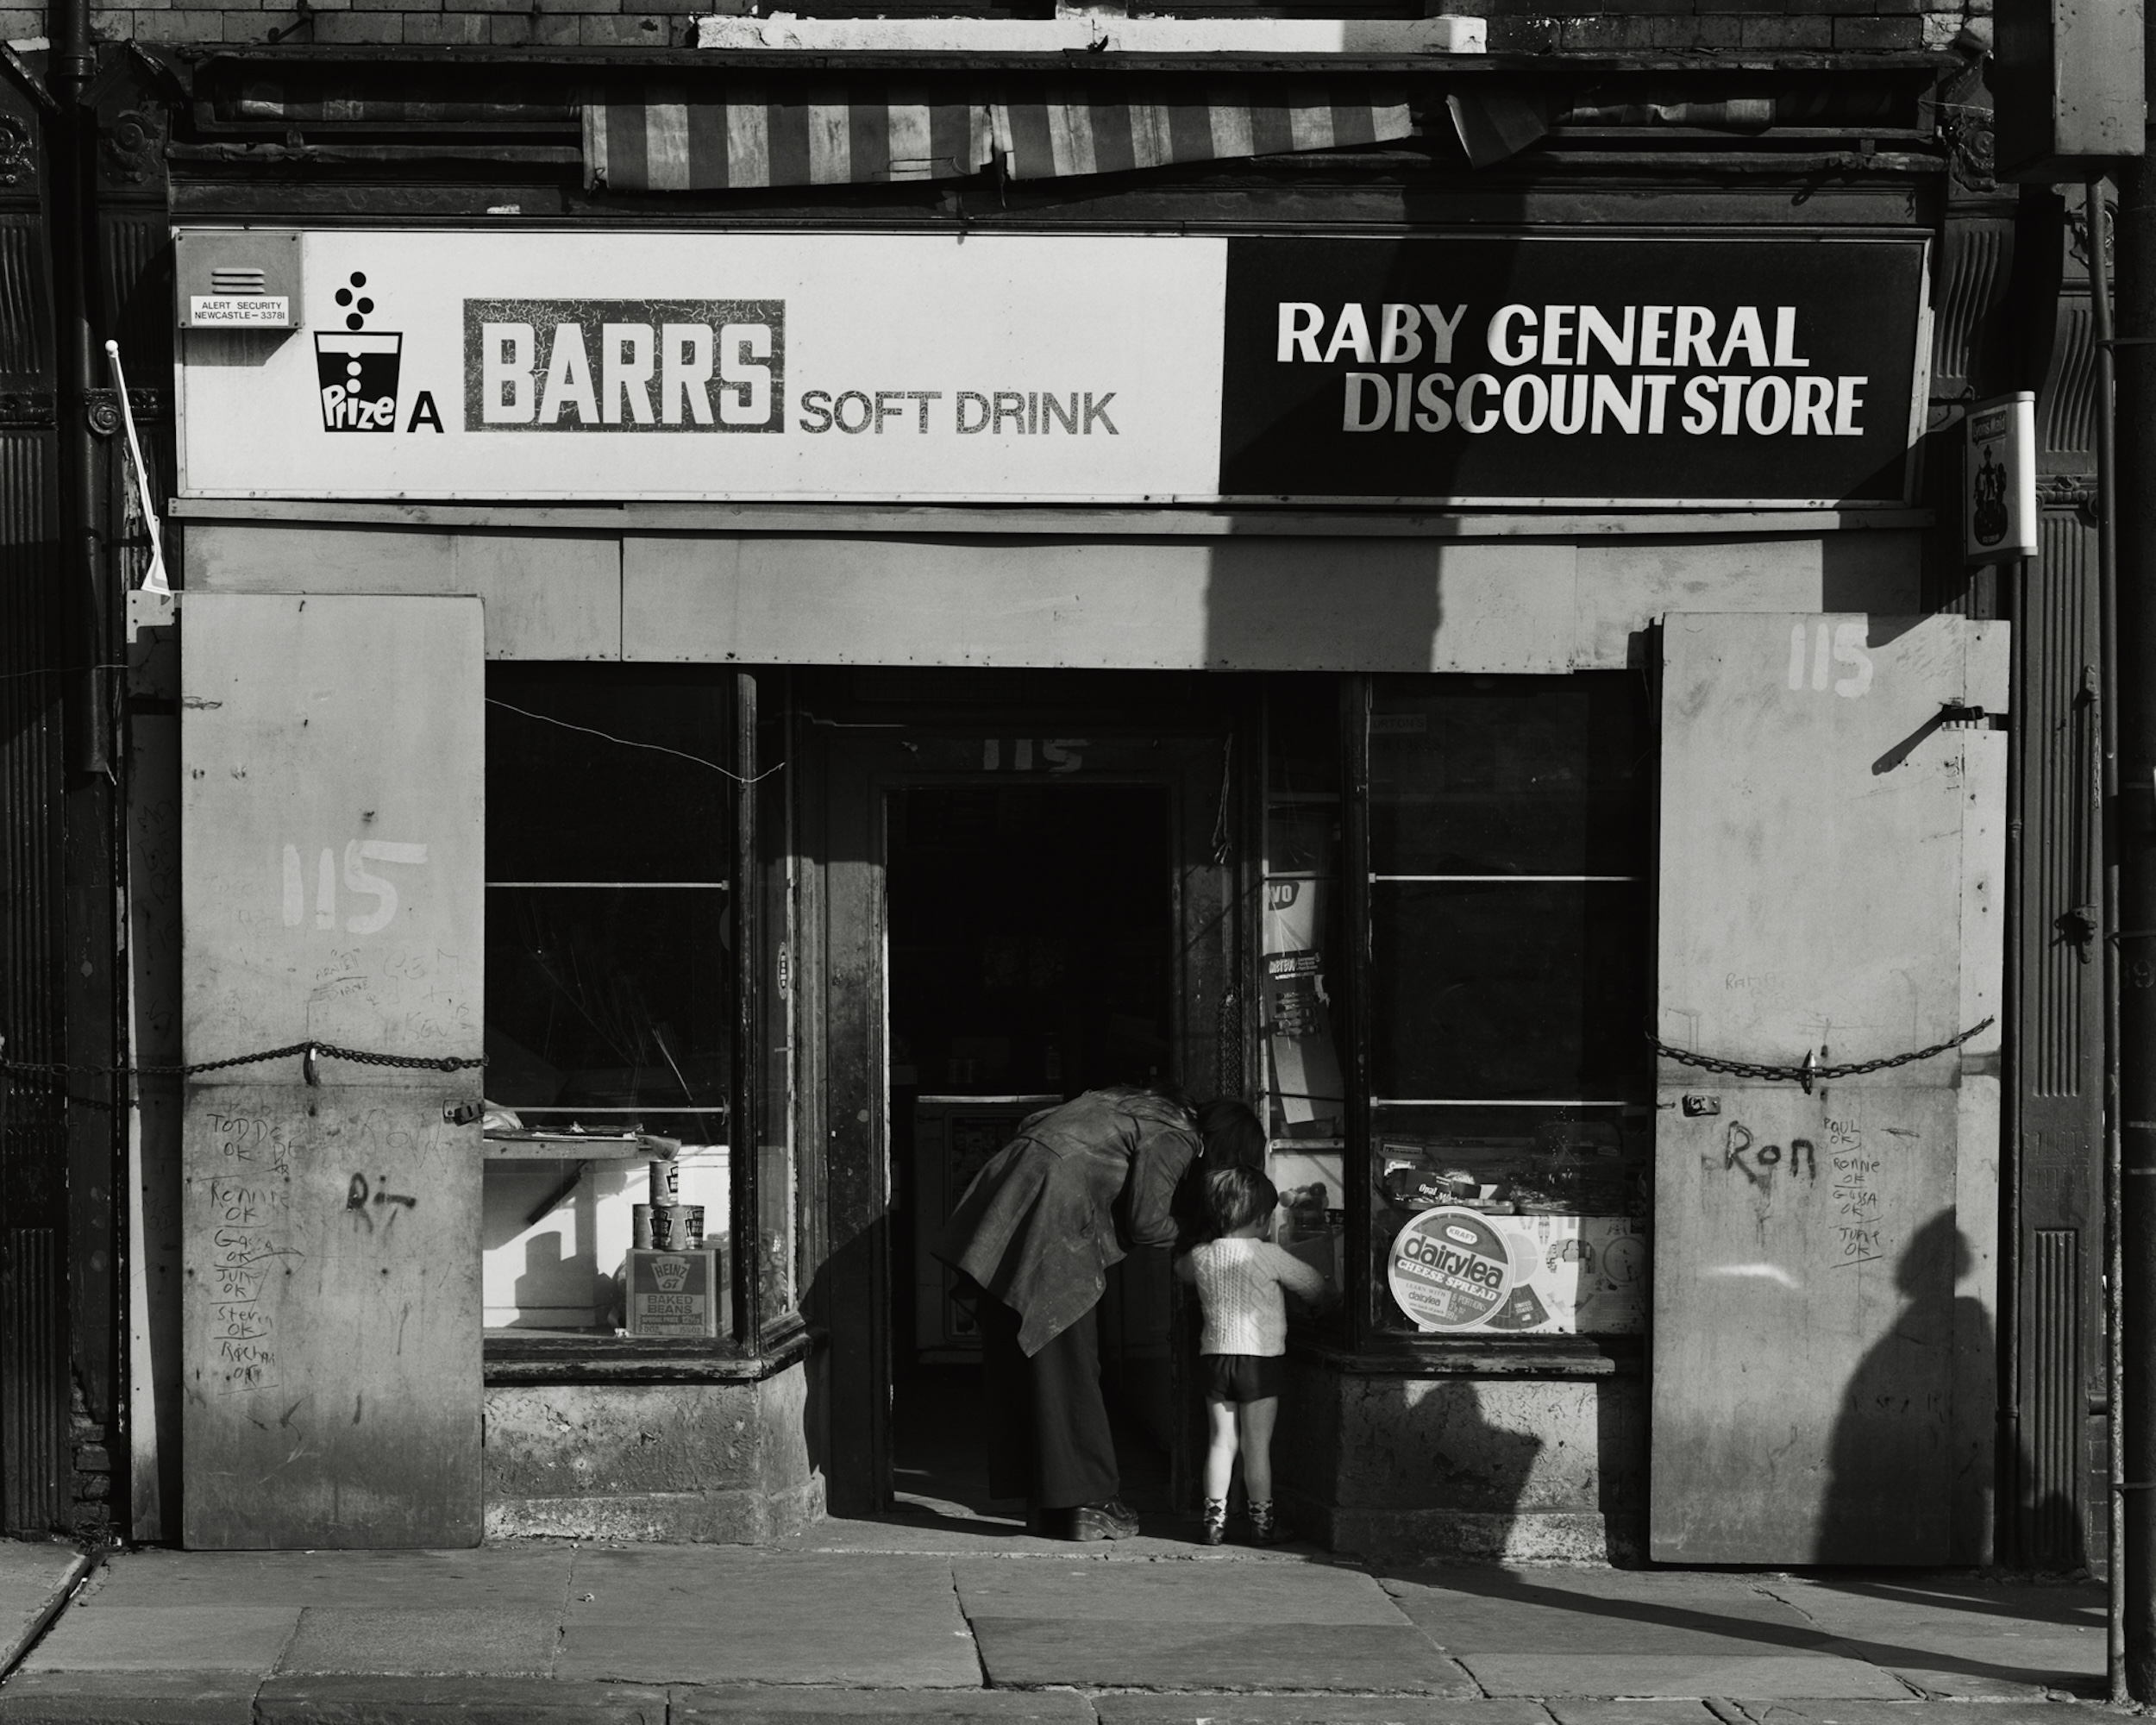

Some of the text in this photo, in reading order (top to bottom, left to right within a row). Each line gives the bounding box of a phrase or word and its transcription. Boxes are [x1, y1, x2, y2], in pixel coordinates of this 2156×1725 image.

[1277, 303, 1809, 367] RABY GENERAL
[481, 322, 773, 425] BARRS
[322, 382, 444, 433] Prize A
[799, 390, 1119, 436] SOFT DRINK
[1343, 372, 1868, 436] DISCOUNT STORE
[1789, 624, 1873, 698] 115
[982, 737, 1097, 774] 115
[282, 838, 428, 934] 115
[224, 1141, 256, 1162] OK
[1725, 1120, 1816, 1189] Ron
[225, 1206, 258, 1223] OK
[1449, 1226, 1476, 1242] KRAFT
[226, 1250, 251, 1264] OK
[1404, 1235, 1504, 1289] dairylea
[1844, 1242, 1871, 1256] OK
[655, 1264, 688, 1279] HEINZ
[661, 1278, 680, 1289] 57
[1397, 1258, 1498, 1302] CHEESE SPREAD
[223, 1283, 247, 1298] OK
[648, 1295, 693, 1305] BAKED
[648, 1304, 693, 1314] BEANS
[228, 1322, 255, 1339] OK
